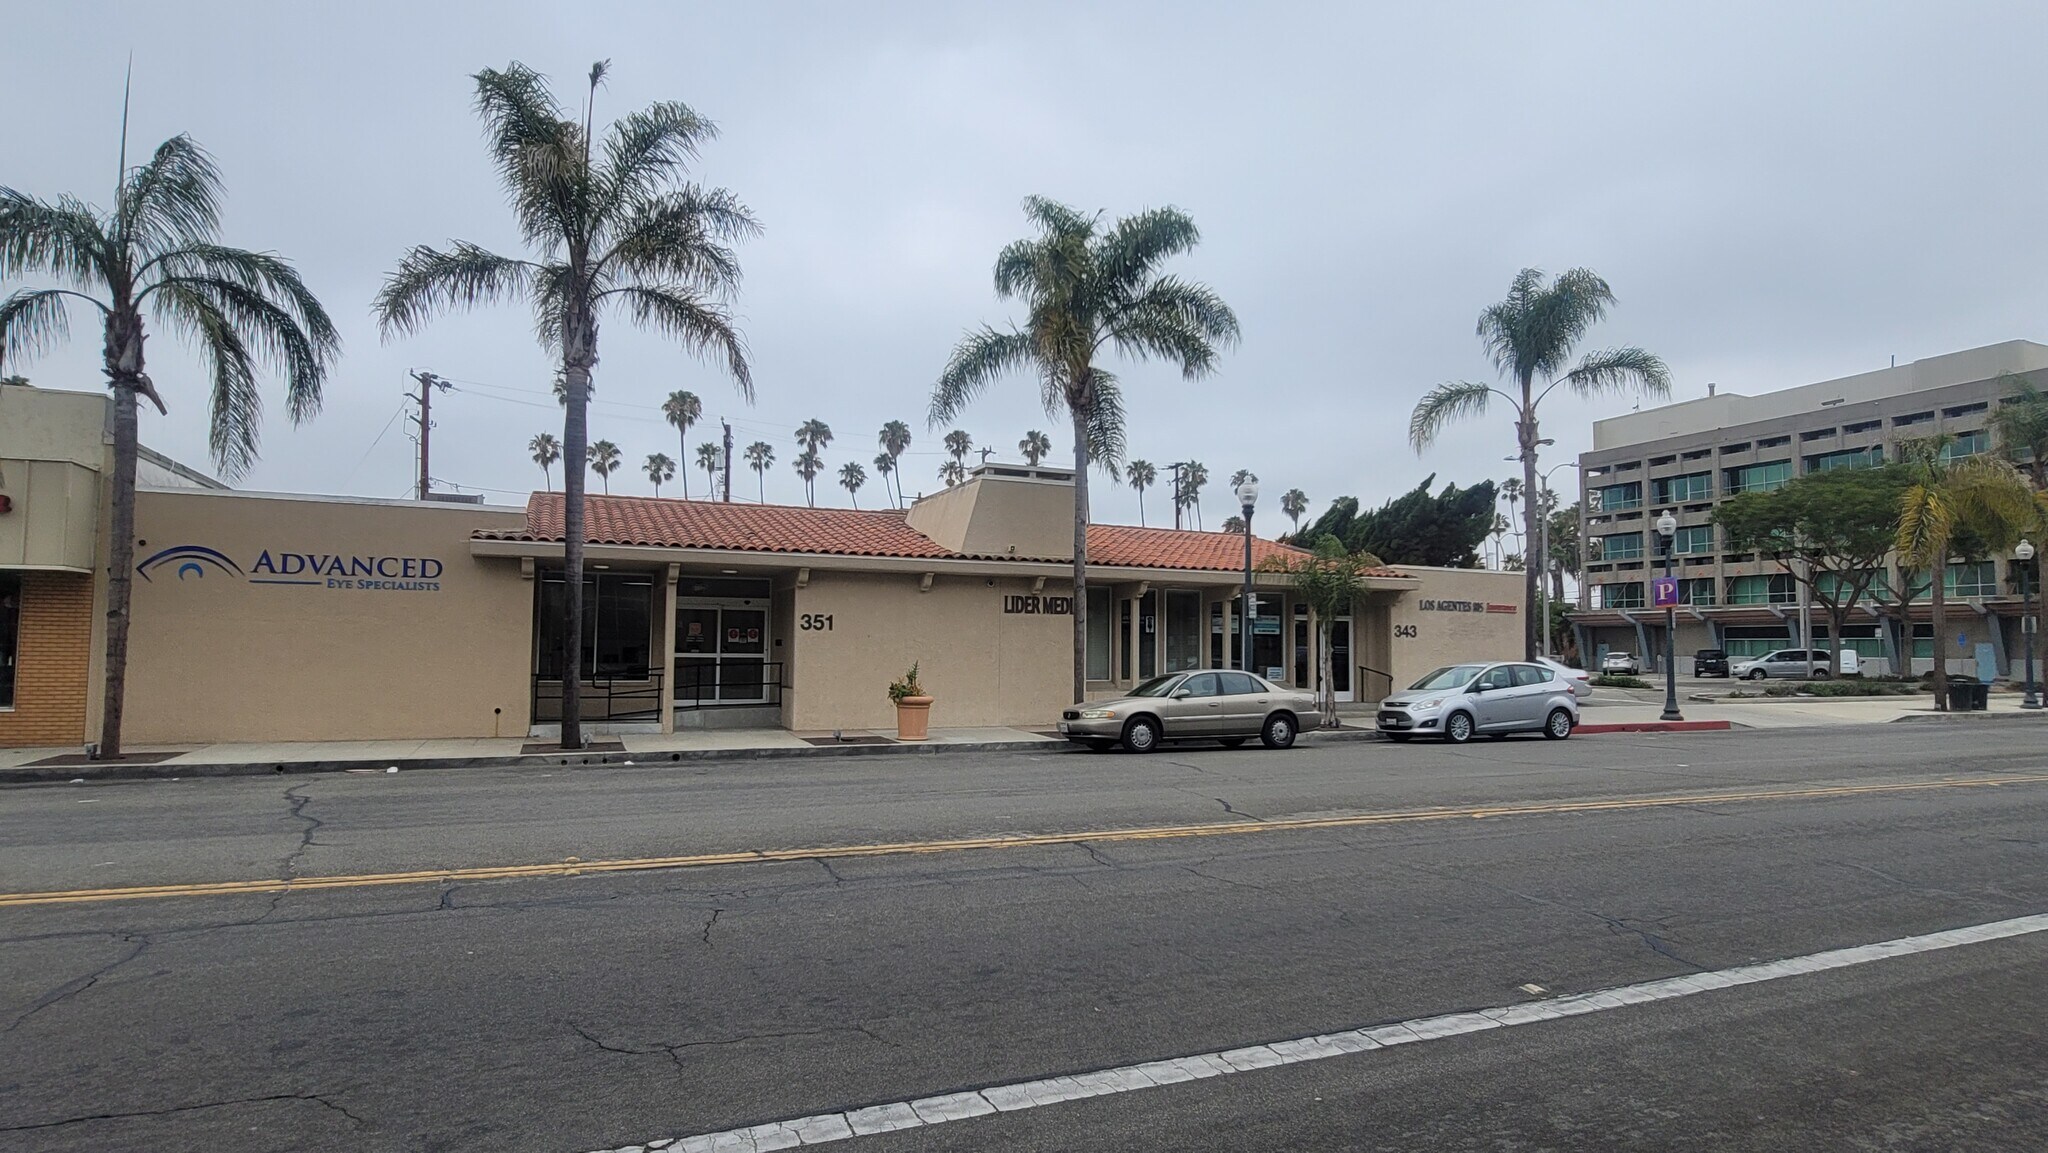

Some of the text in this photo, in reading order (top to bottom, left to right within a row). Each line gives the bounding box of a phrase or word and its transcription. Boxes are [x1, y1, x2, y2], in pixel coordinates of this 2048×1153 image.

[250, 549, 443, 578] ADVANCED
[327, 578, 440, 591] EYE SPECIALISTS
[1656, 583, 1674, 600] P
[1004, 595, 1041, 614] LIDER
[1419, 600, 1434, 611] LOS
[1436, 600, 1471, 612] AGENTES
[800, 614, 833, 631] 351
[1394, 624, 1417, 638] 343
